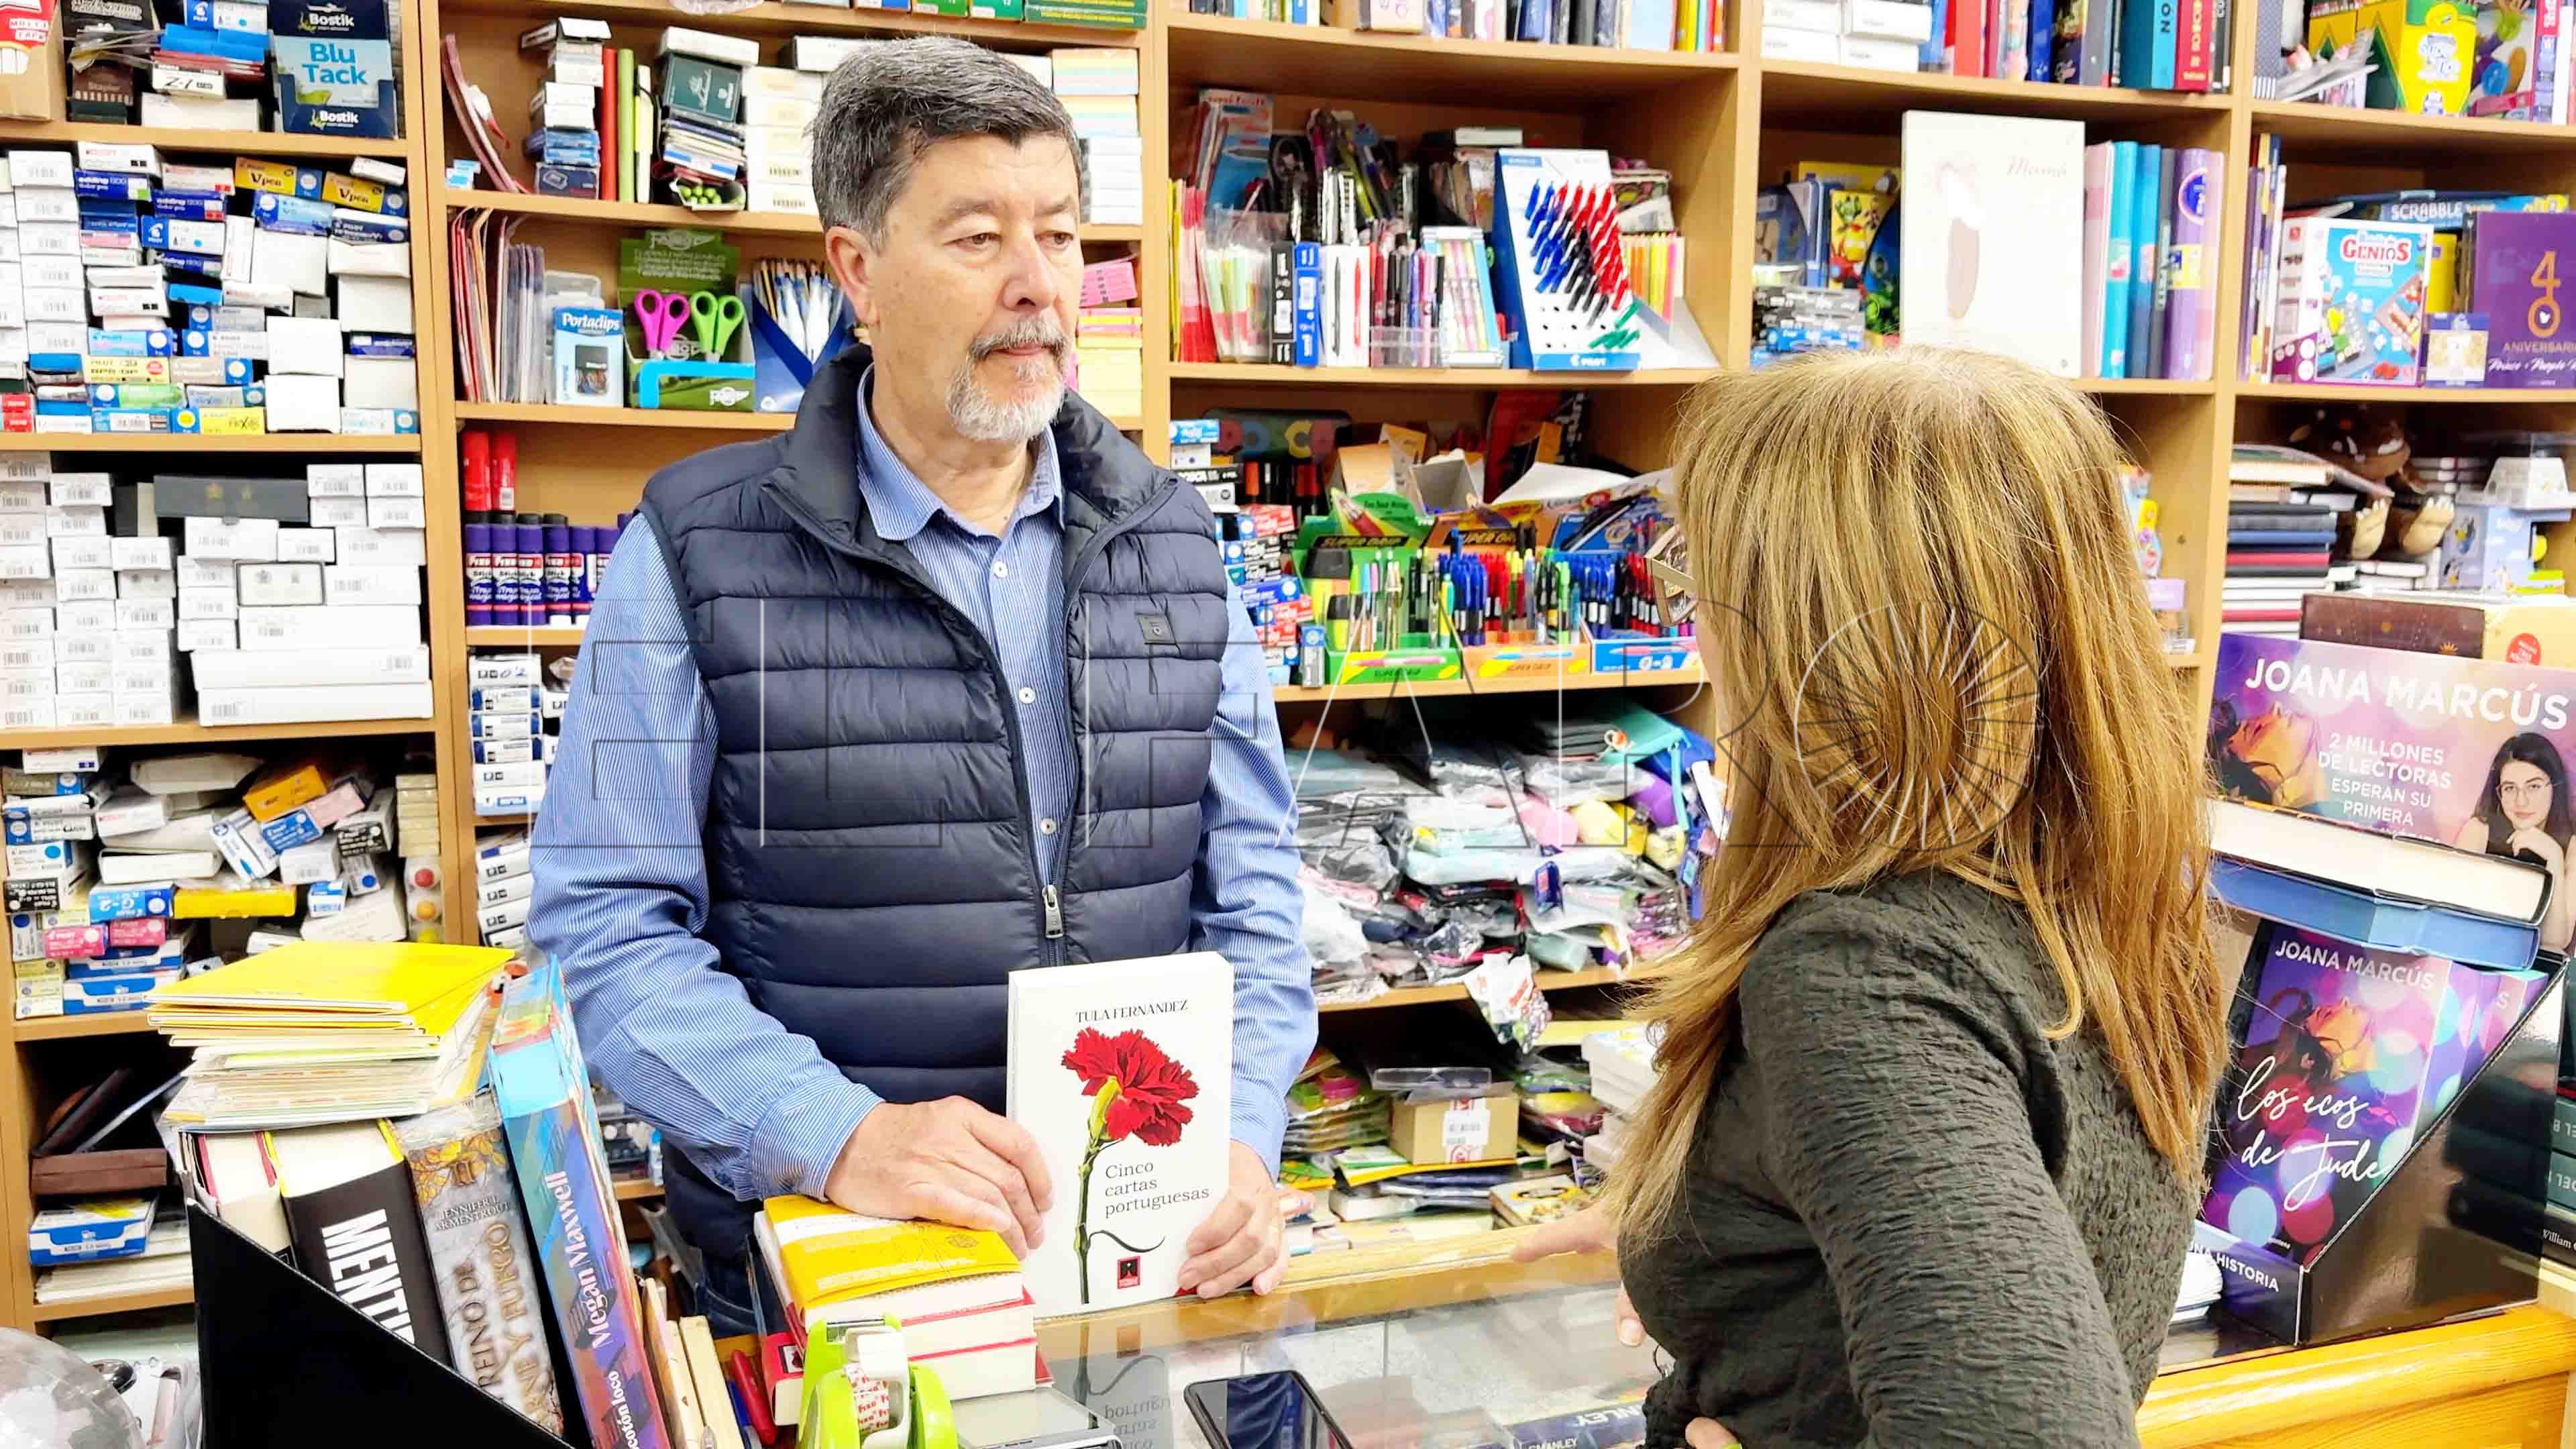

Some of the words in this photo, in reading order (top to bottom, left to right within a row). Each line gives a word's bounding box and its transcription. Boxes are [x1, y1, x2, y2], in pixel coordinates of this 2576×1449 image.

[310, 13, 354, 27] Bostik
[310, 43, 355, 63] Blu
[303, 65, 368, 85] Tack
[320, 110, 359, 123] Bostik
[2391, 202, 2463, 220] SCRABBLE
[2245, 658, 2371, 704] JOANA
[2385, 675, 2569, 730] MARCÚS
[2329, 733, 2341, 749] 2
[2346, 735, 2445, 765] MILLONES
[2318, 751, 2342, 771] DE
[2349, 757, 2453, 789] LECTORAS
[2331, 777, 2406, 802] ESPERAN
[2410, 792, 2431, 808] SU
[2343, 800, 2414, 827] PRIMERA
[2275, 939, 2341, 971] JOANA
[2346, 956, 2436, 991] MARCÚS
[1076, 1008, 1111, 1023] TULA
[2302, 1091, 2369, 1129] ecos
[1106, 1161, 1154, 1179] Cinco
[2241, 1130, 2286, 1169] de
[2284, 1136, 2390, 1212] Jude
[1105, 1179, 1158, 1197] cartas
[1106, 1187, 1210, 1218] portuguesas
[435, 1201, 511, 1232] ARMENTROUT
[439, 1198, 488, 1220] JENNIFER
[543, 1170, 588, 1267] Maxwell
[2542, 1228, 2571, 1249] William
[321, 1208, 415, 1344] MENTI
[486, 1222, 529, 1323] FUEGO
[2216, 1252, 2279, 1293] HISTORIA
[578, 1266, 612, 1349] Megan
[462, 1300, 498, 1389] REINO
[608, 1369, 630, 1405] loco
